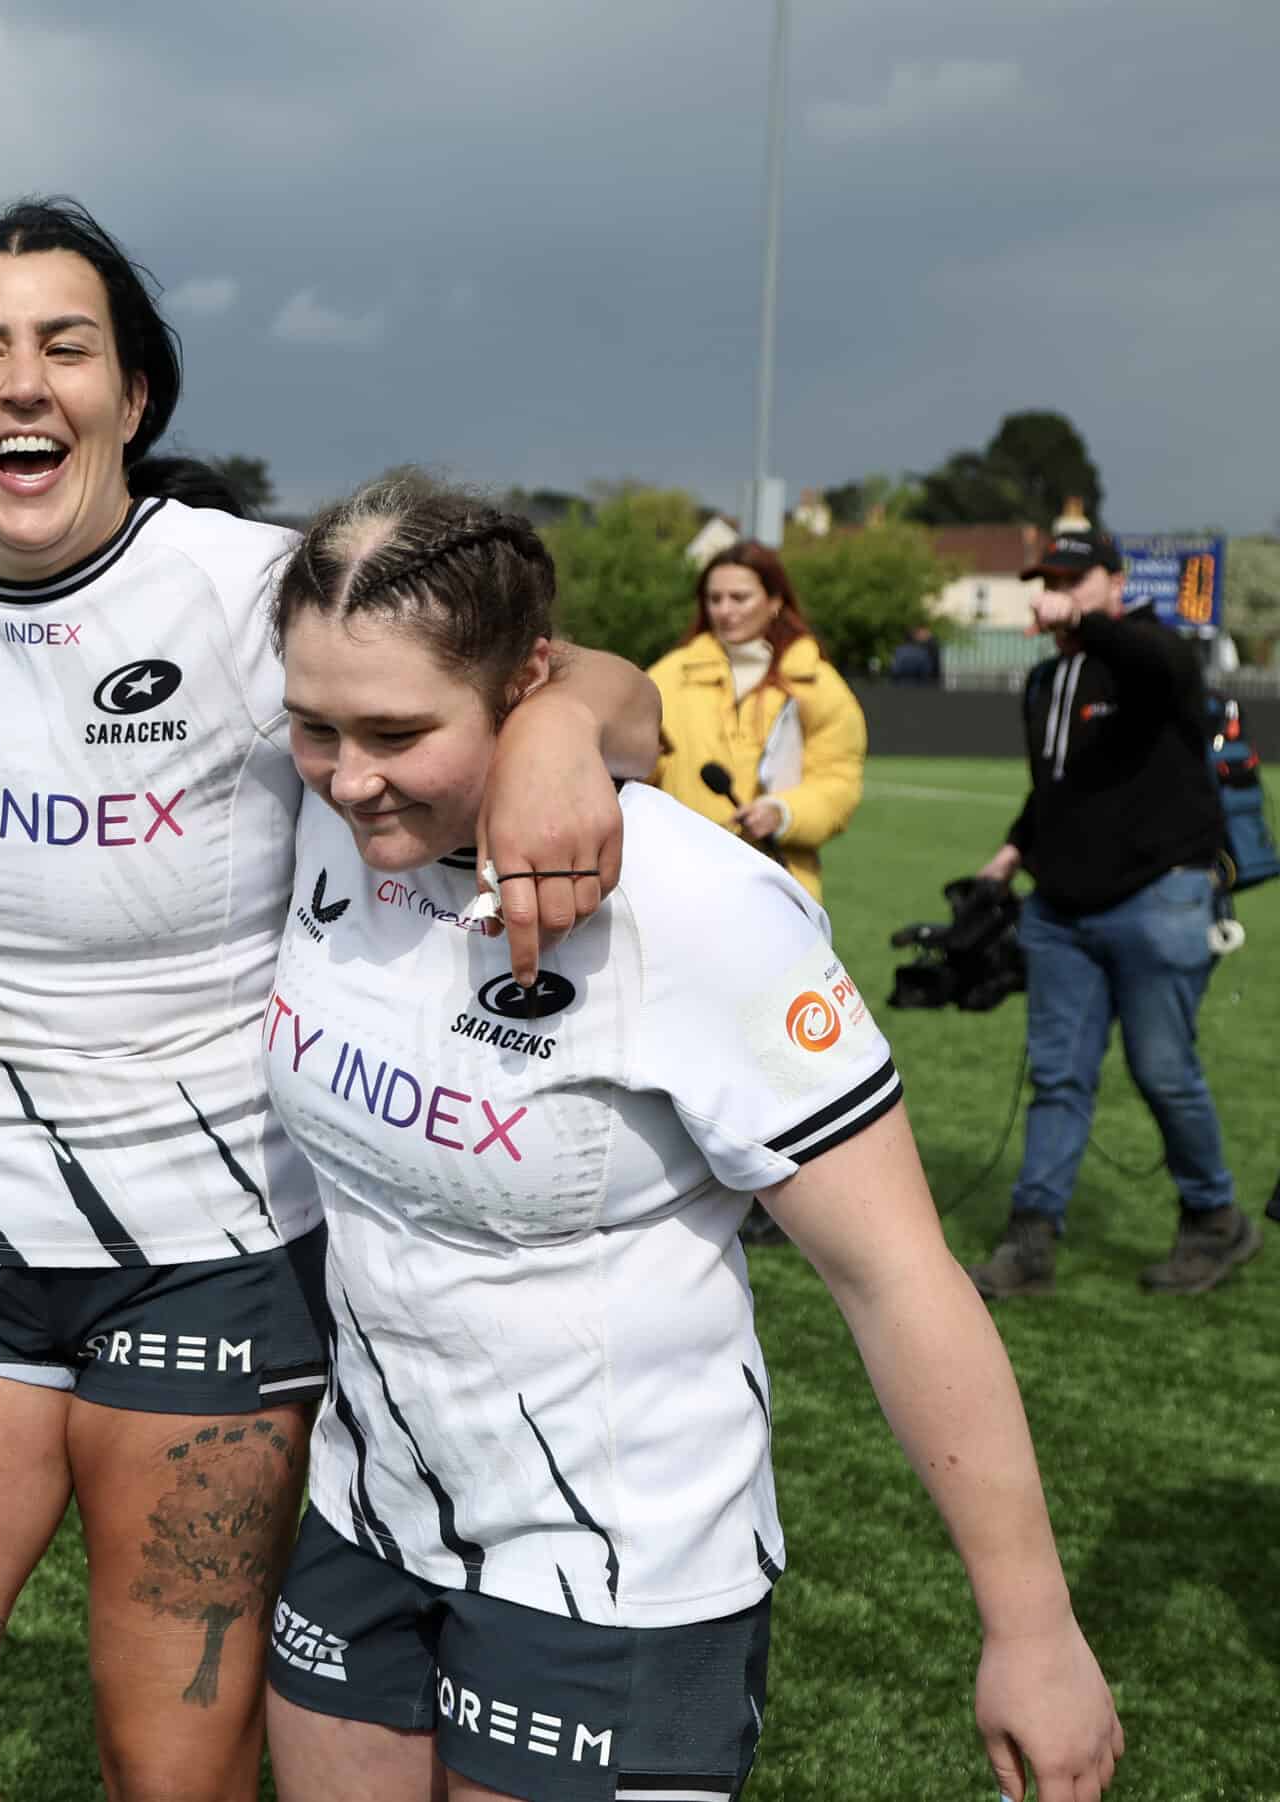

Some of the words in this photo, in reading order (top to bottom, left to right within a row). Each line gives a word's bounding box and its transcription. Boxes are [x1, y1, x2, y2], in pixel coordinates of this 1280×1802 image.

[5, 623, 82, 646] INDEX
[85, 720, 187, 745] SARACENS
[377, 879, 417, 912] CITY
[297, 906, 324, 943] CASTORE
[831, 975, 856, 1007] PW
[451, 1013, 557, 1060] SARACENS
[331, 1041, 527, 1162] INDEX
[437, 1667, 613, 1767] QREEM
